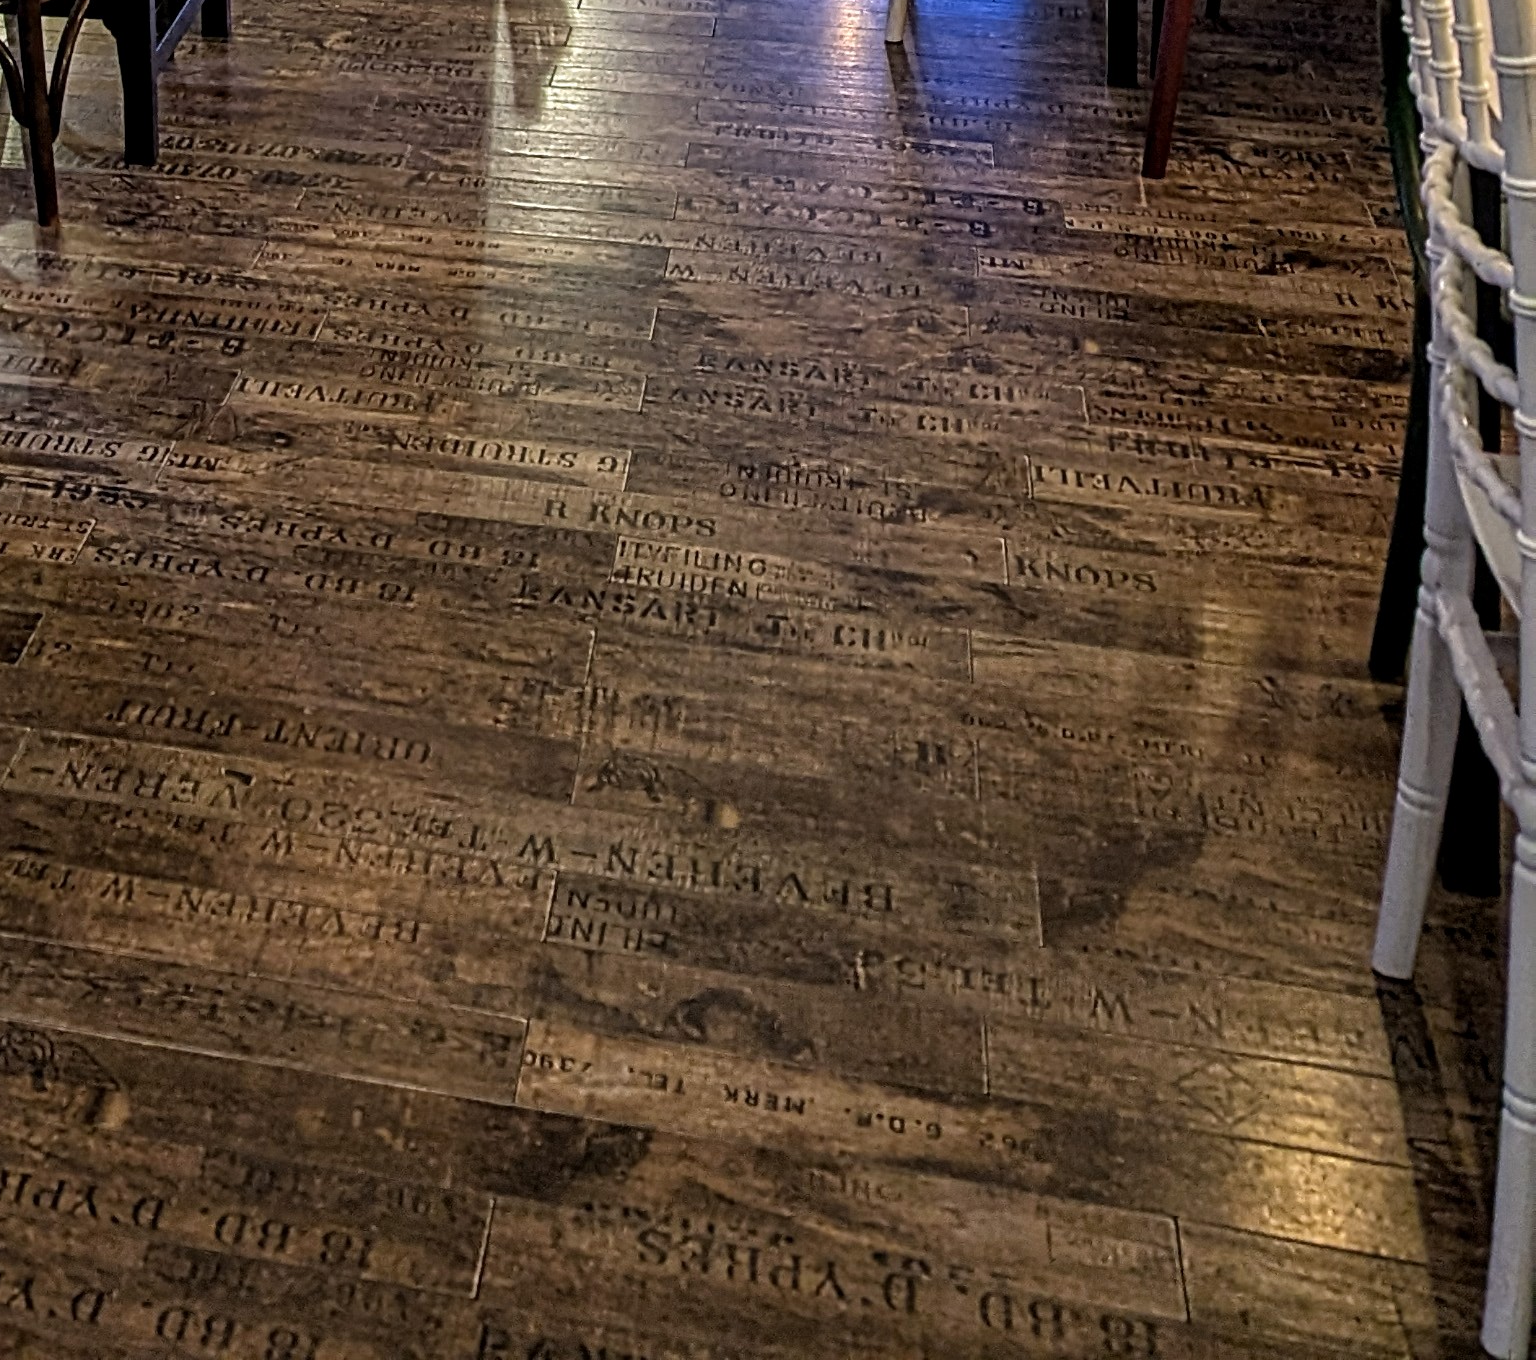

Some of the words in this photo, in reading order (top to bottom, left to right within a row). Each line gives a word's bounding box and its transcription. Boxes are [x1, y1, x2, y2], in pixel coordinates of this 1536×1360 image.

[542, 496, 569, 521] R
[586, 500, 718, 540] KNOPS
[1014, 553, 1159, 595] KNOPS
[318, 1229, 374, 1271] 18
[633, 1225, 922, 1318] D'YPRES
